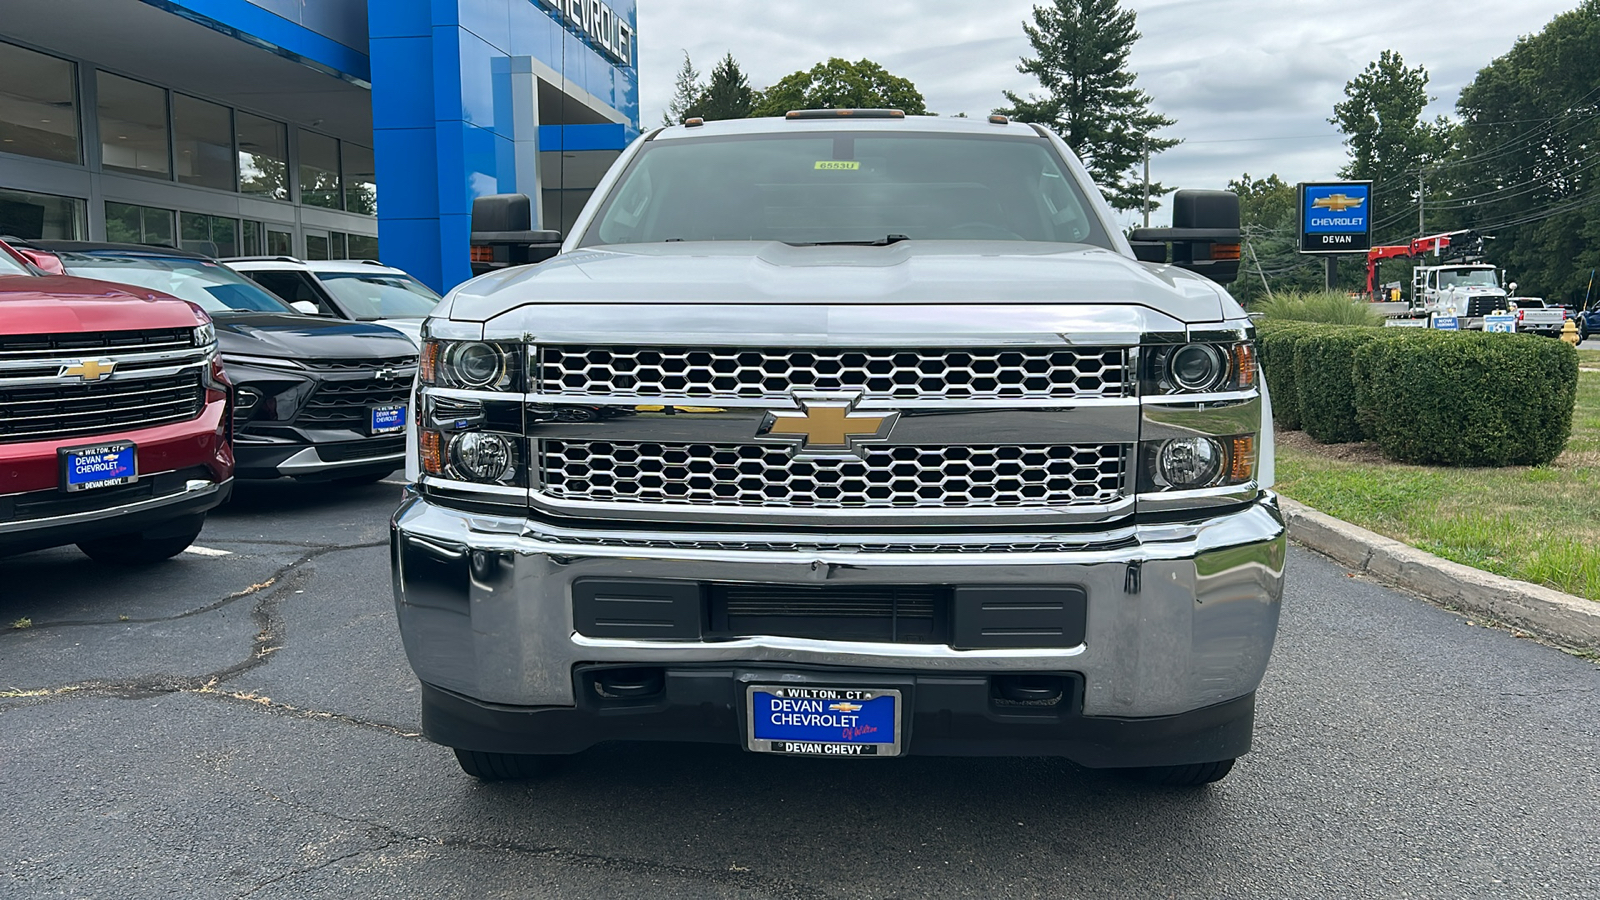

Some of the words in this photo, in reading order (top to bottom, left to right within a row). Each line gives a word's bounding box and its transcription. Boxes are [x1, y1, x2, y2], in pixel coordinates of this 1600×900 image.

[1311, 217, 1363, 226] CHEVROLET
[1322, 235, 1352, 243] DEVAN
[75, 455, 101, 466] DEVAN
[76, 461, 118, 474] CHEVROLET
[85, 480, 104, 489] DEVAN
[104, 477, 122, 486] CHEVY
[846, 691, 862, 700] CT
[770, 699, 823, 712] DEVAN
[770, 713, 859, 728] CHEVROLET
[785, 742, 822, 753] DEVAN
[824, 744, 863, 755] CHEVY
